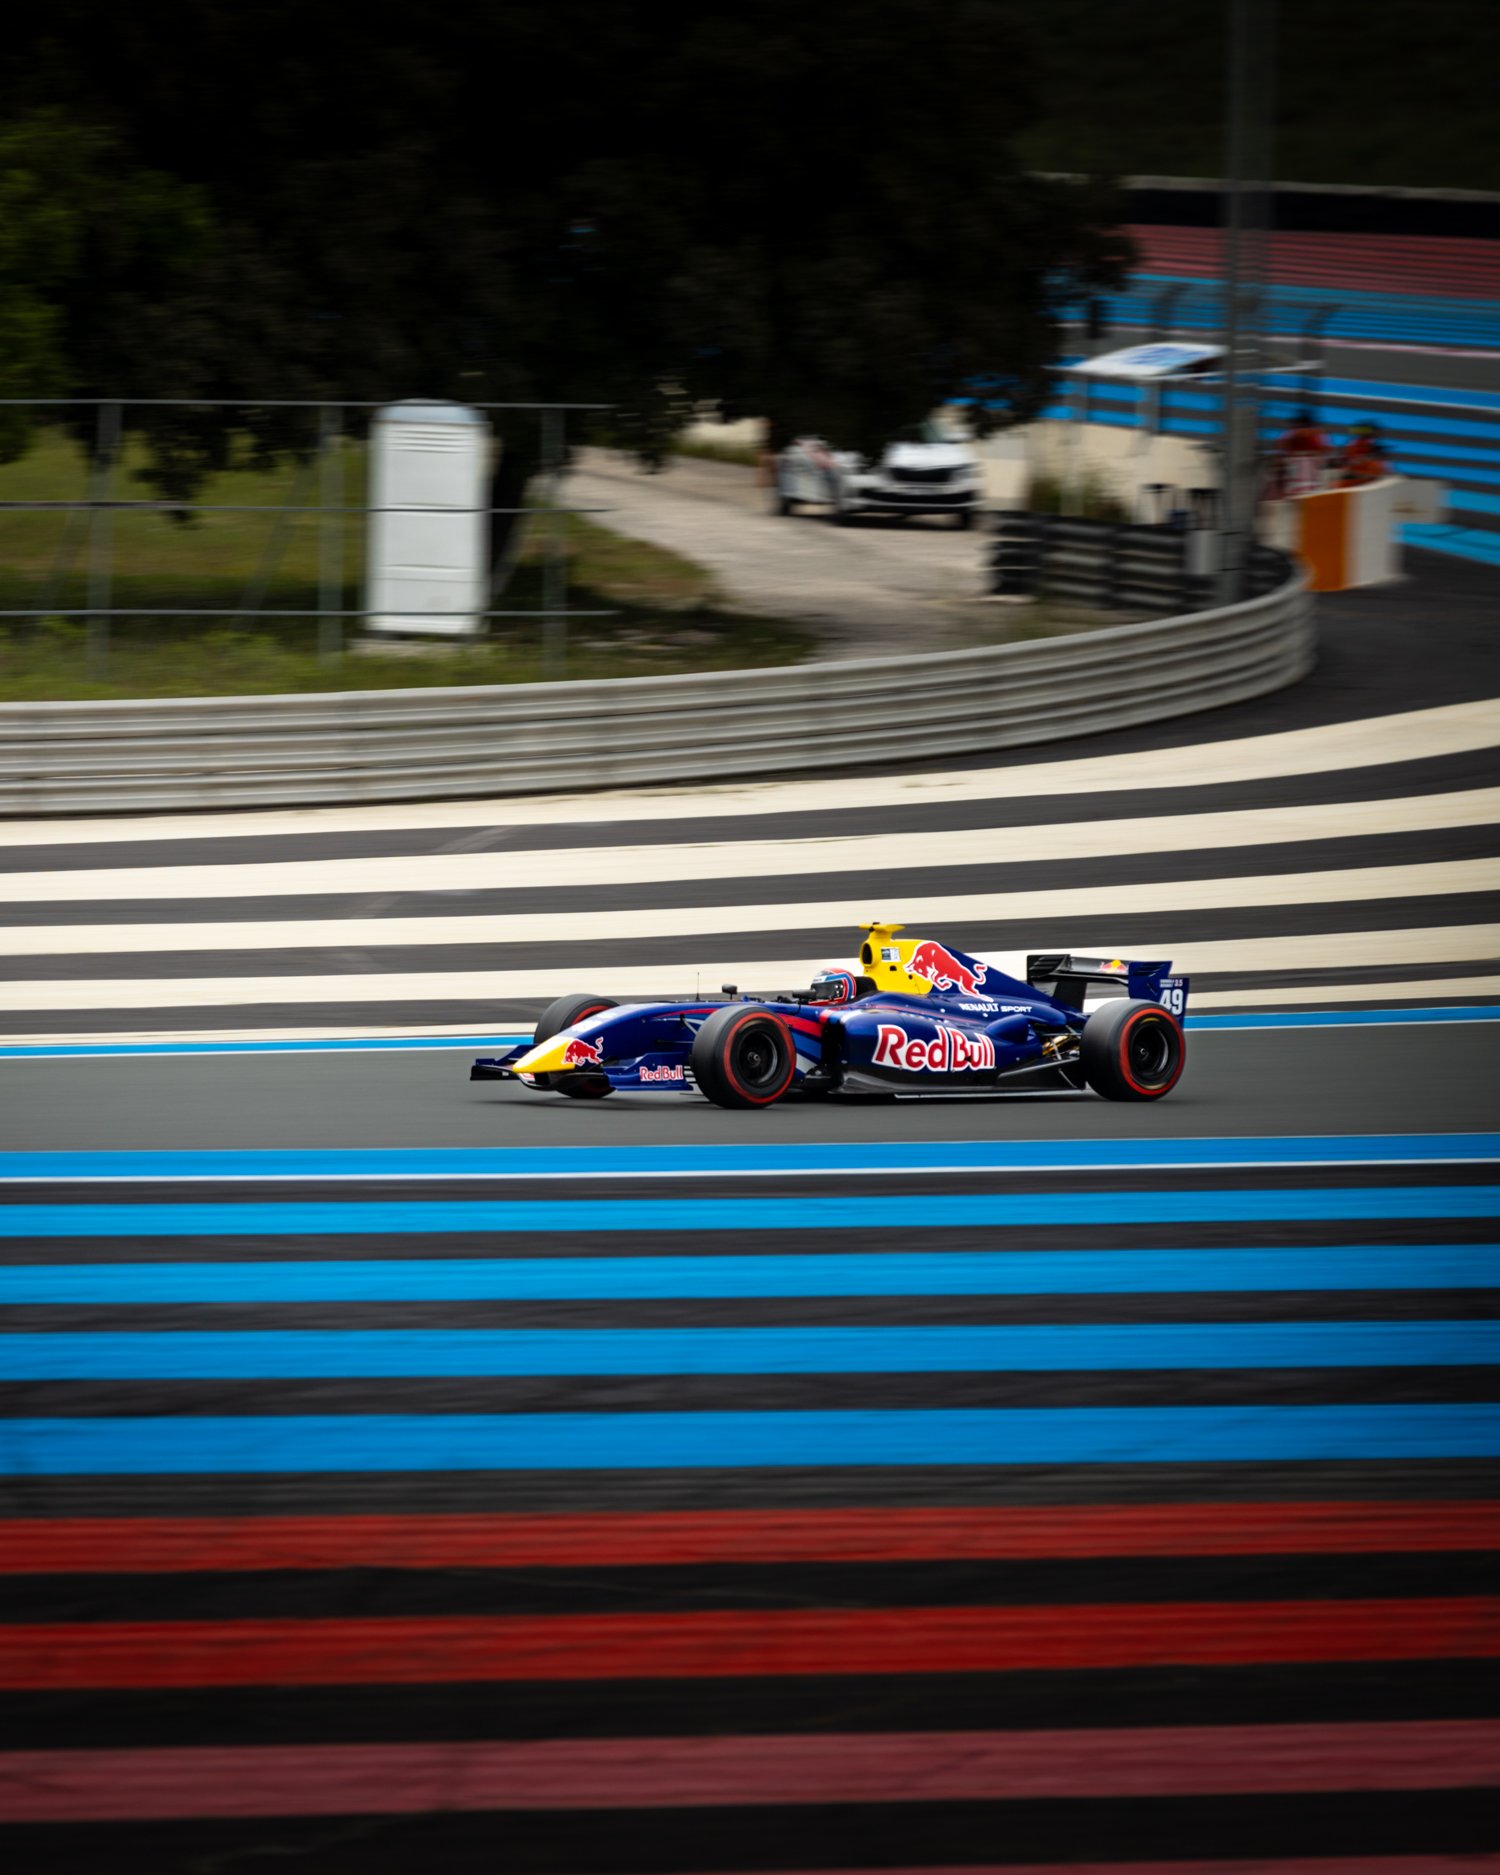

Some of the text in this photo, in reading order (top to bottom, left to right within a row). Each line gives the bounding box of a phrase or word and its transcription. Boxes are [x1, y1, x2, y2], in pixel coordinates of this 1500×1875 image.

[958, 1003, 1033, 1013] RENAULT SPORT
[1160, 989, 1183, 1015] 49
